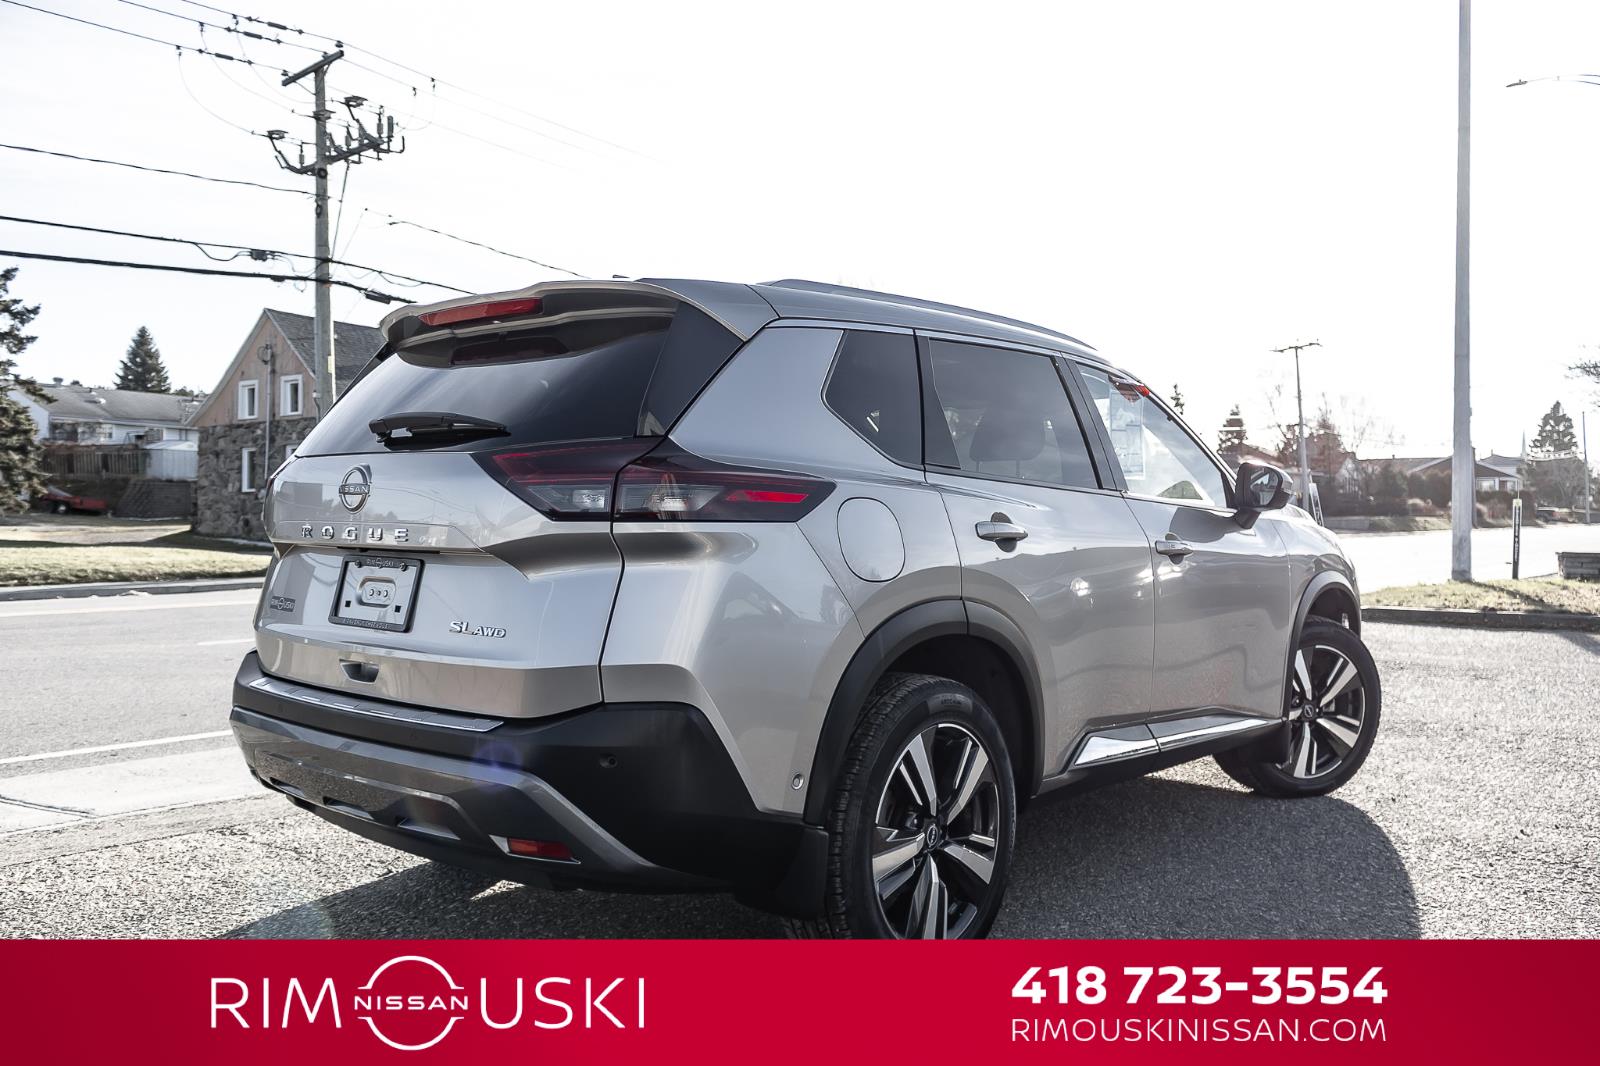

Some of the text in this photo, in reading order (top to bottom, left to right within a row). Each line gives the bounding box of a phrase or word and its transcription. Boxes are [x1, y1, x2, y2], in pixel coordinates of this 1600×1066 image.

[339, 485, 369, 494] SSAN
[301, 524, 408, 542] ROGUE
[450, 621, 507, 639] SL AWD
